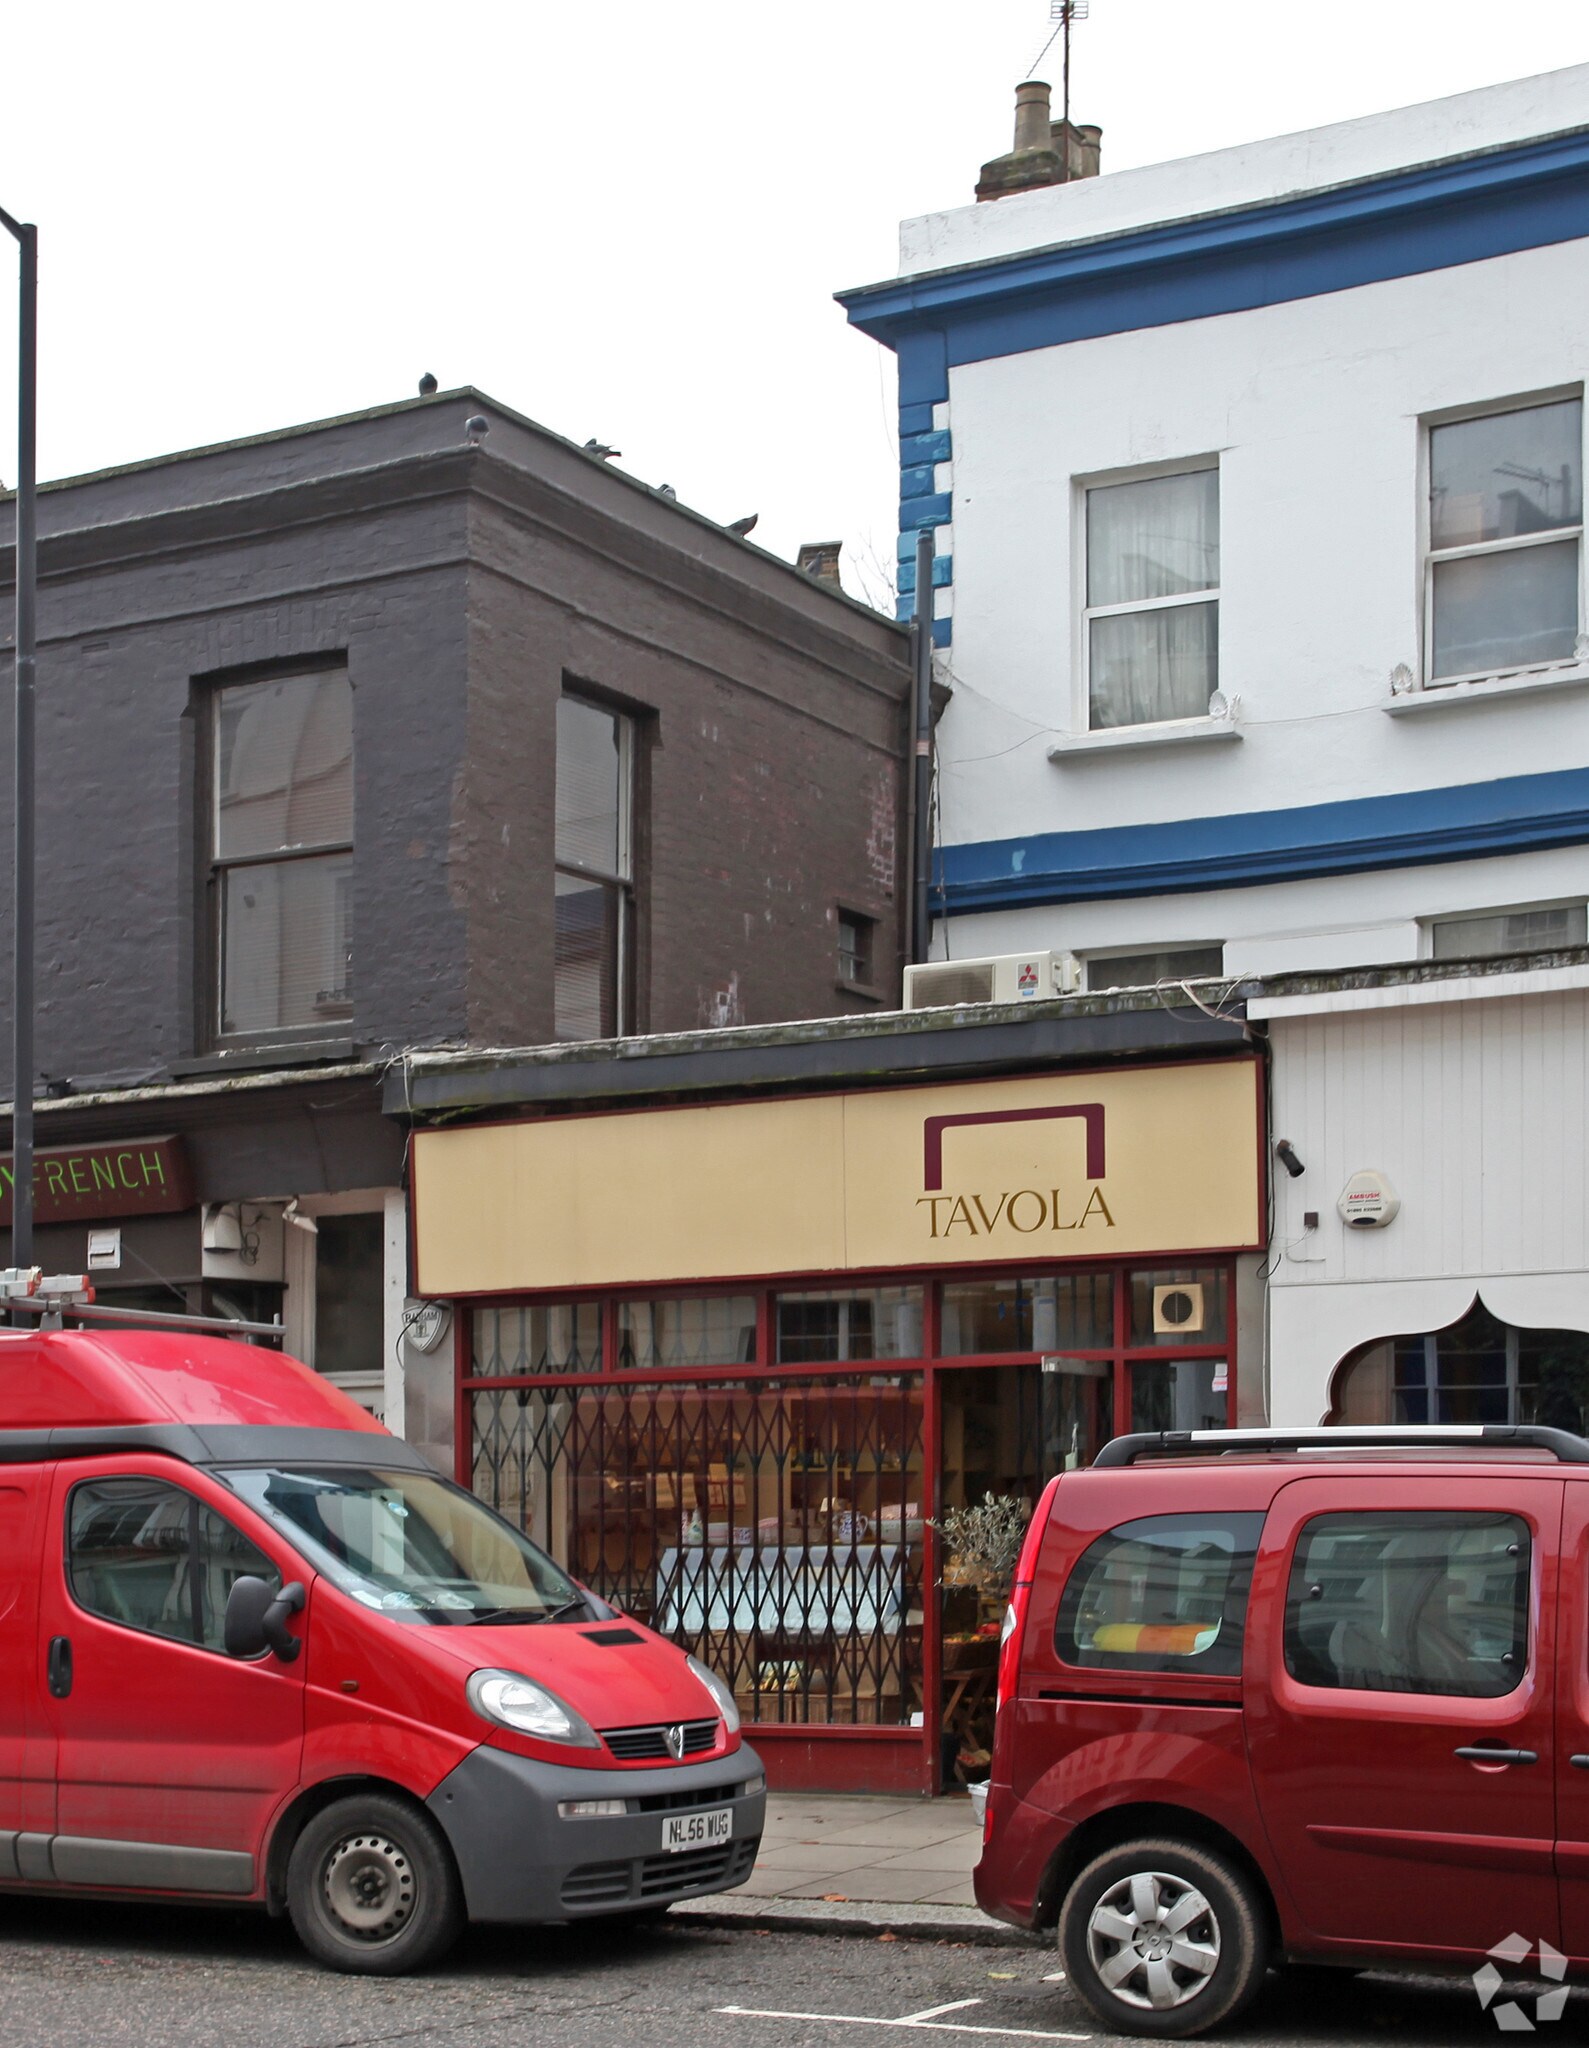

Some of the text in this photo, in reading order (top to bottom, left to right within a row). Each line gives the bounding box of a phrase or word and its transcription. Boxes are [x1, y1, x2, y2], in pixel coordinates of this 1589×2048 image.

[915, 1185, 1116, 1238] TAVOLA
[669, 1813, 728, 1844] NL56 WUG
